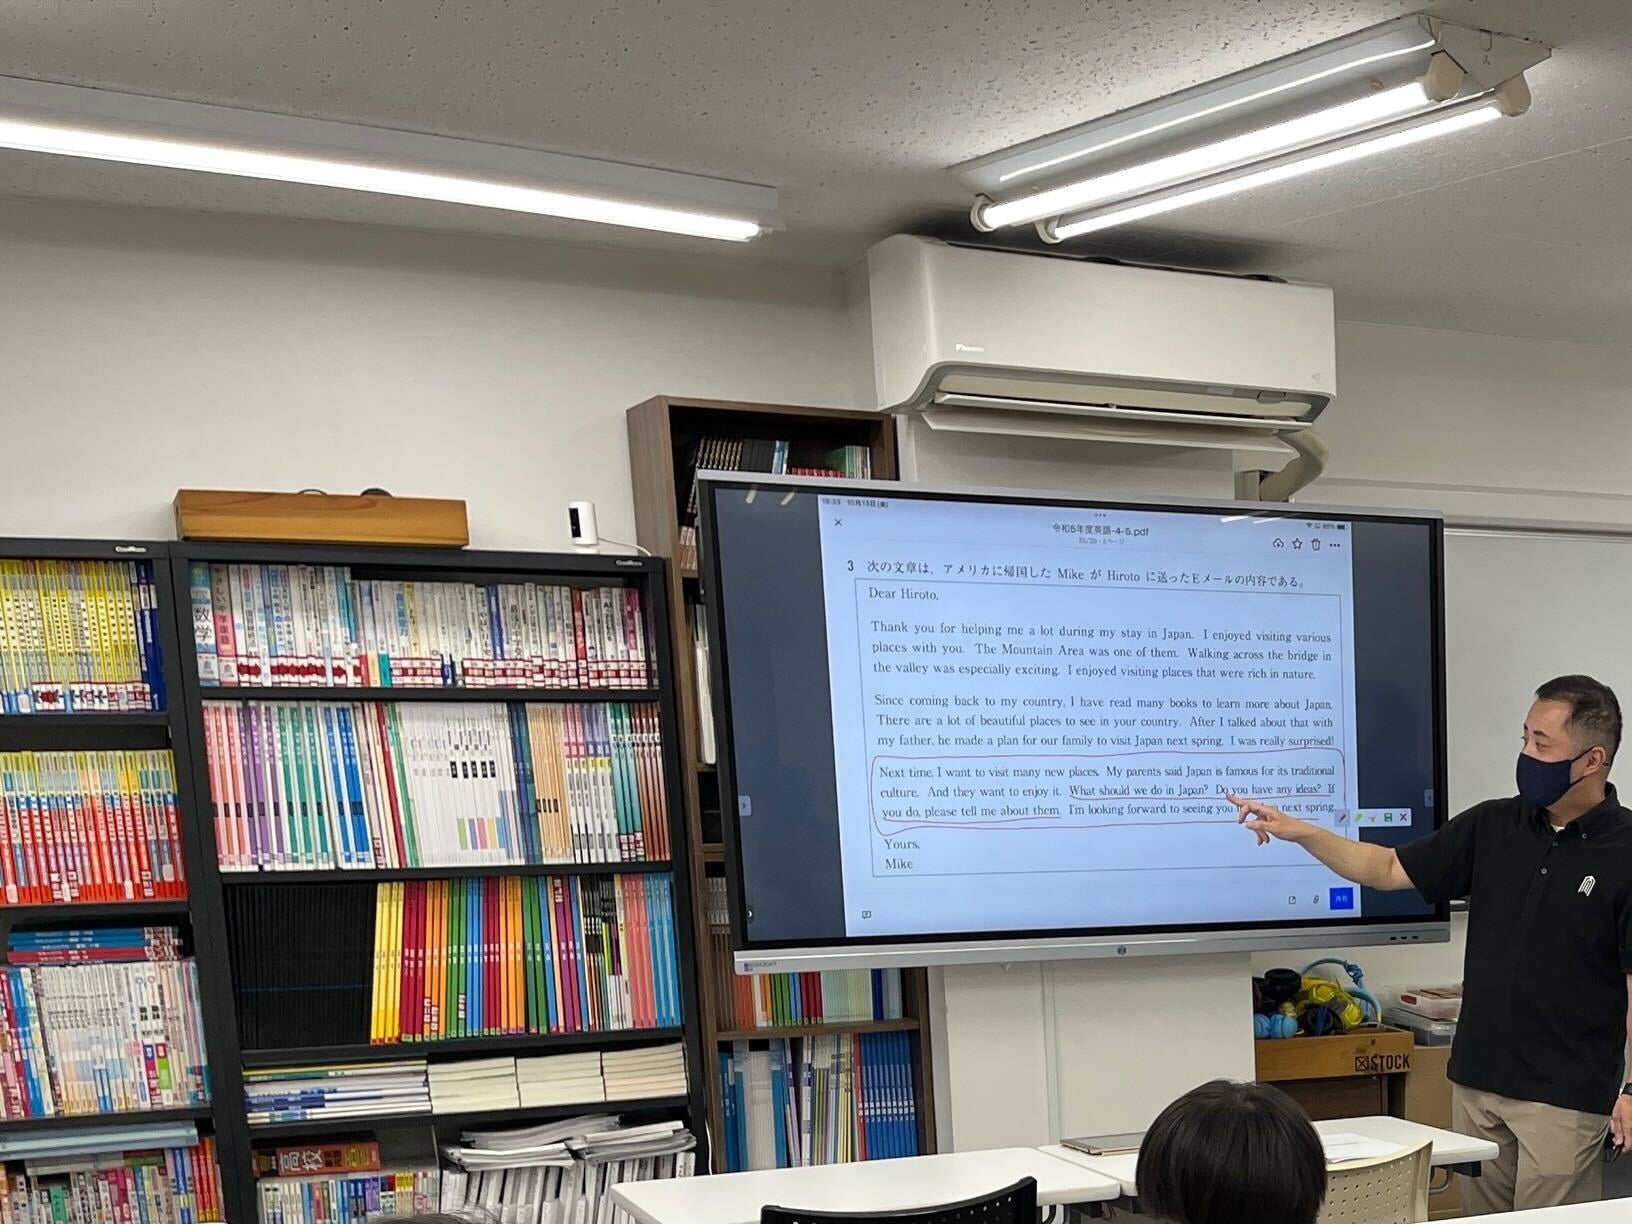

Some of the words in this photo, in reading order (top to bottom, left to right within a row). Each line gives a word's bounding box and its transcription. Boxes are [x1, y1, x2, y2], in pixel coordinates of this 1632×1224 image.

[847, 561, 854, 572] 3
[1058, 567, 1084, 580] Mike
[1090, 568, 1102, 580] が
[1107, 569, 1140, 582] Hiroto
[869, 587, 896, 599] Dear
[870, 620, 908, 632] Thank
[914, 624, 934, 634] you
[940, 622, 956, 633] for
[962, 623, 1002, 636] helping
[1007, 627, 1024, 636] me
[1027, 627, 1033, 636] a
[1040, 625, 1054, 636] lot
[1059, 625, 1094, 638] during
[1099, 629, 1116, 640] my
[1120, 628, 1142, 640] stay
[1148, 628, 1158, 638] in
[1203, 628, 1209, 640] I
[1212, 630, 1252, 642] enjoyed
[1256, 631, 1292, 644] visiting
[1296, 632, 1332, 643] various
[872, 641, 907, 654] places
[912, 642, 937, 653] with
[974, 643, 996, 654] The
[1002, 643, 1053, 655] Mountain
[1058, 644, 1084, 656] Area
[1089, 648, 1110, 656] was
[1113, 648, 1132, 657] one
[1136, 646, 1147, 658] of
[1187, 647, 1229, 661] Walking
[1233, 651, 1264, 660] across
[1268, 650, 1284, 660] the
[1287, 649, 1318, 662] bridge
[1322, 650, 1332, 662] in
[873, 661, 891, 672] the
[896, 662, 928, 675] valley
[933, 665, 955, 674] was
[958, 664, 1011, 676] especially
[1068, 664, 1072, 675] I
[1076, 664, 1117, 678] enjoyed
[1120, 666, 1158, 679] visiting
[1162, 666, 1193, 679] places
[1196, 666, 1216, 678] that
[1220, 670, 1244, 678] were
[1248, 668, 1267, 679] rich
[1270, 668, 1279, 679] in
[874, 694, 904, 706] Since
[909, 698, 948, 707] coming
[954, 695, 980, 706] back
[985, 697, 996, 706] to
[1001, 698, 1018, 708] my
[1070, 696, 1074, 707] I
[1080, 696, 1104, 708] have
[1110, 697, 1132, 708] read
[1137, 700, 1164, 710] many
[1169, 697, 1198, 708] books
[1202, 699, 1212, 709] to
[1216, 696, 1240, 709] learn
[1245, 701, 1270, 709] more
[1274, 698, 1300, 710] about
[885, 858, 913, 870] Mike
[1370, 1053, 1411, 1072] STOCK
